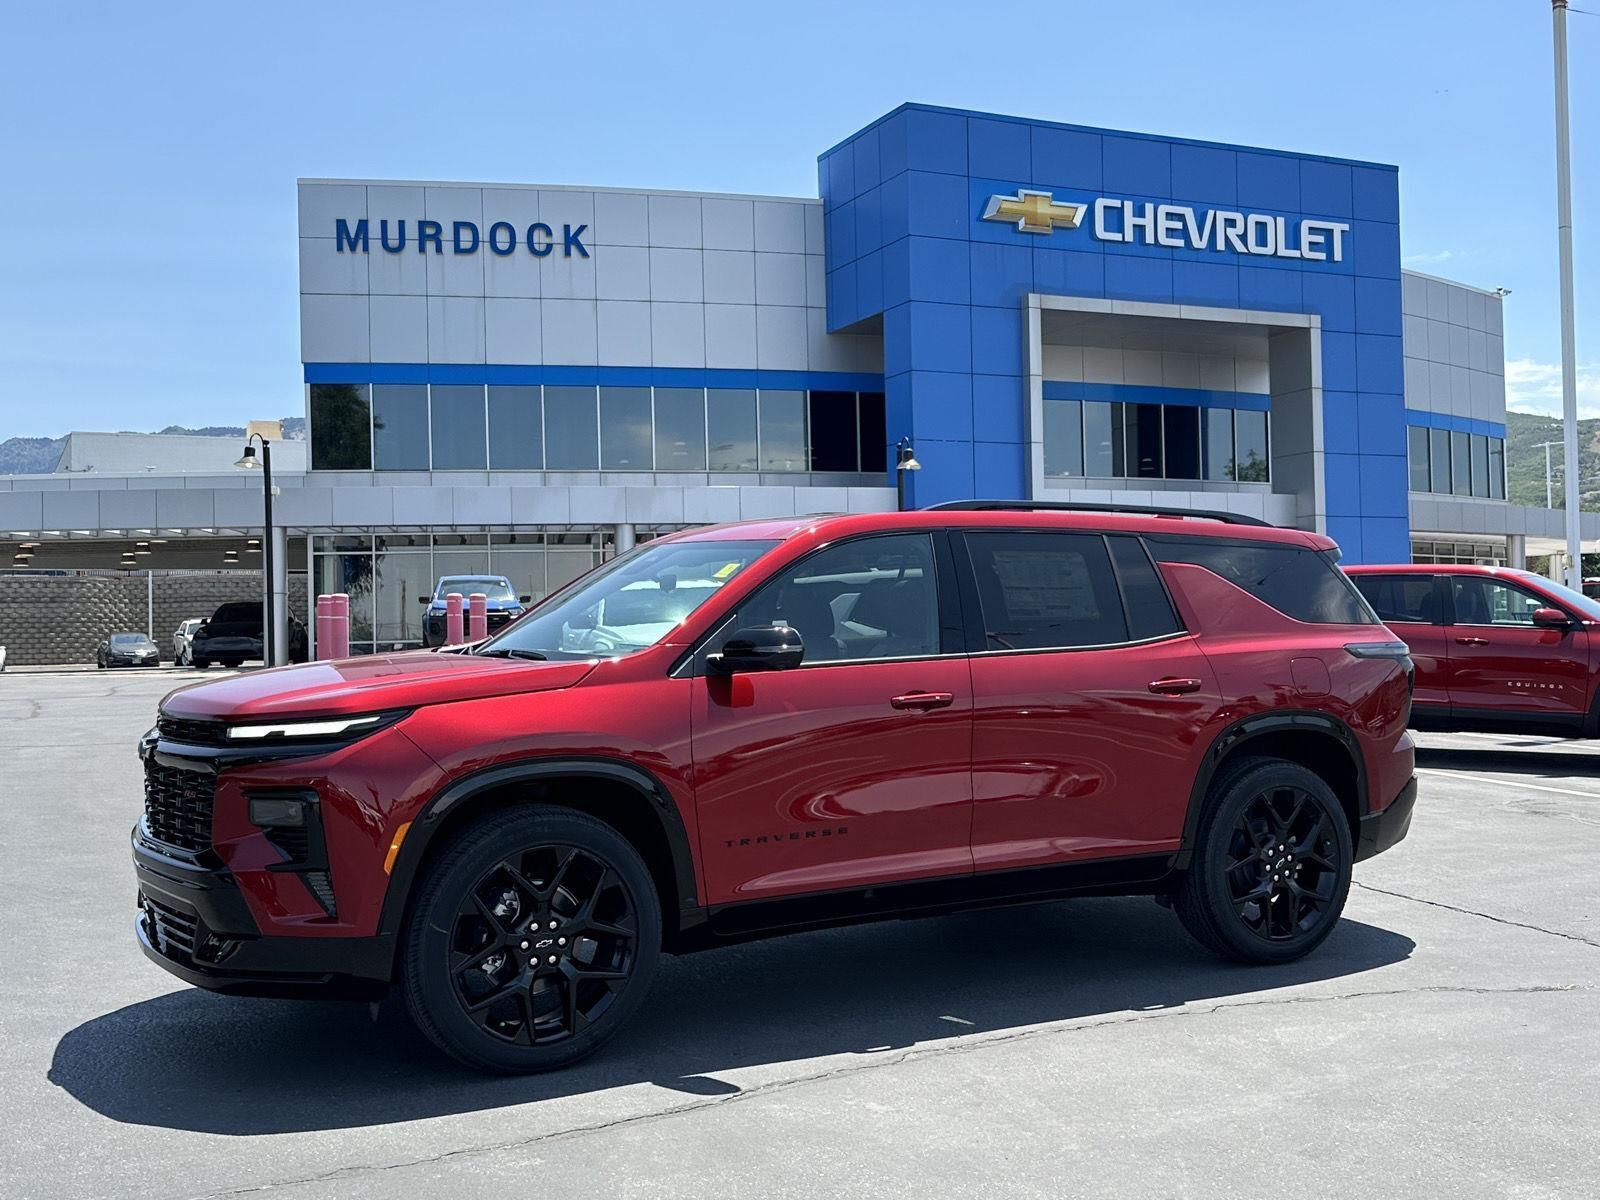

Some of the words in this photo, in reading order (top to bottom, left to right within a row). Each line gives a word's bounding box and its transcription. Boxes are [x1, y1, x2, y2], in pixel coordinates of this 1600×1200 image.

[336, 219, 590, 258] MURDOCK
[1094, 197, 1349, 262] CHEVROLET
[1507, 681, 1564, 689] EQUINOX
[724, 827, 849, 847] TRAVERSE
